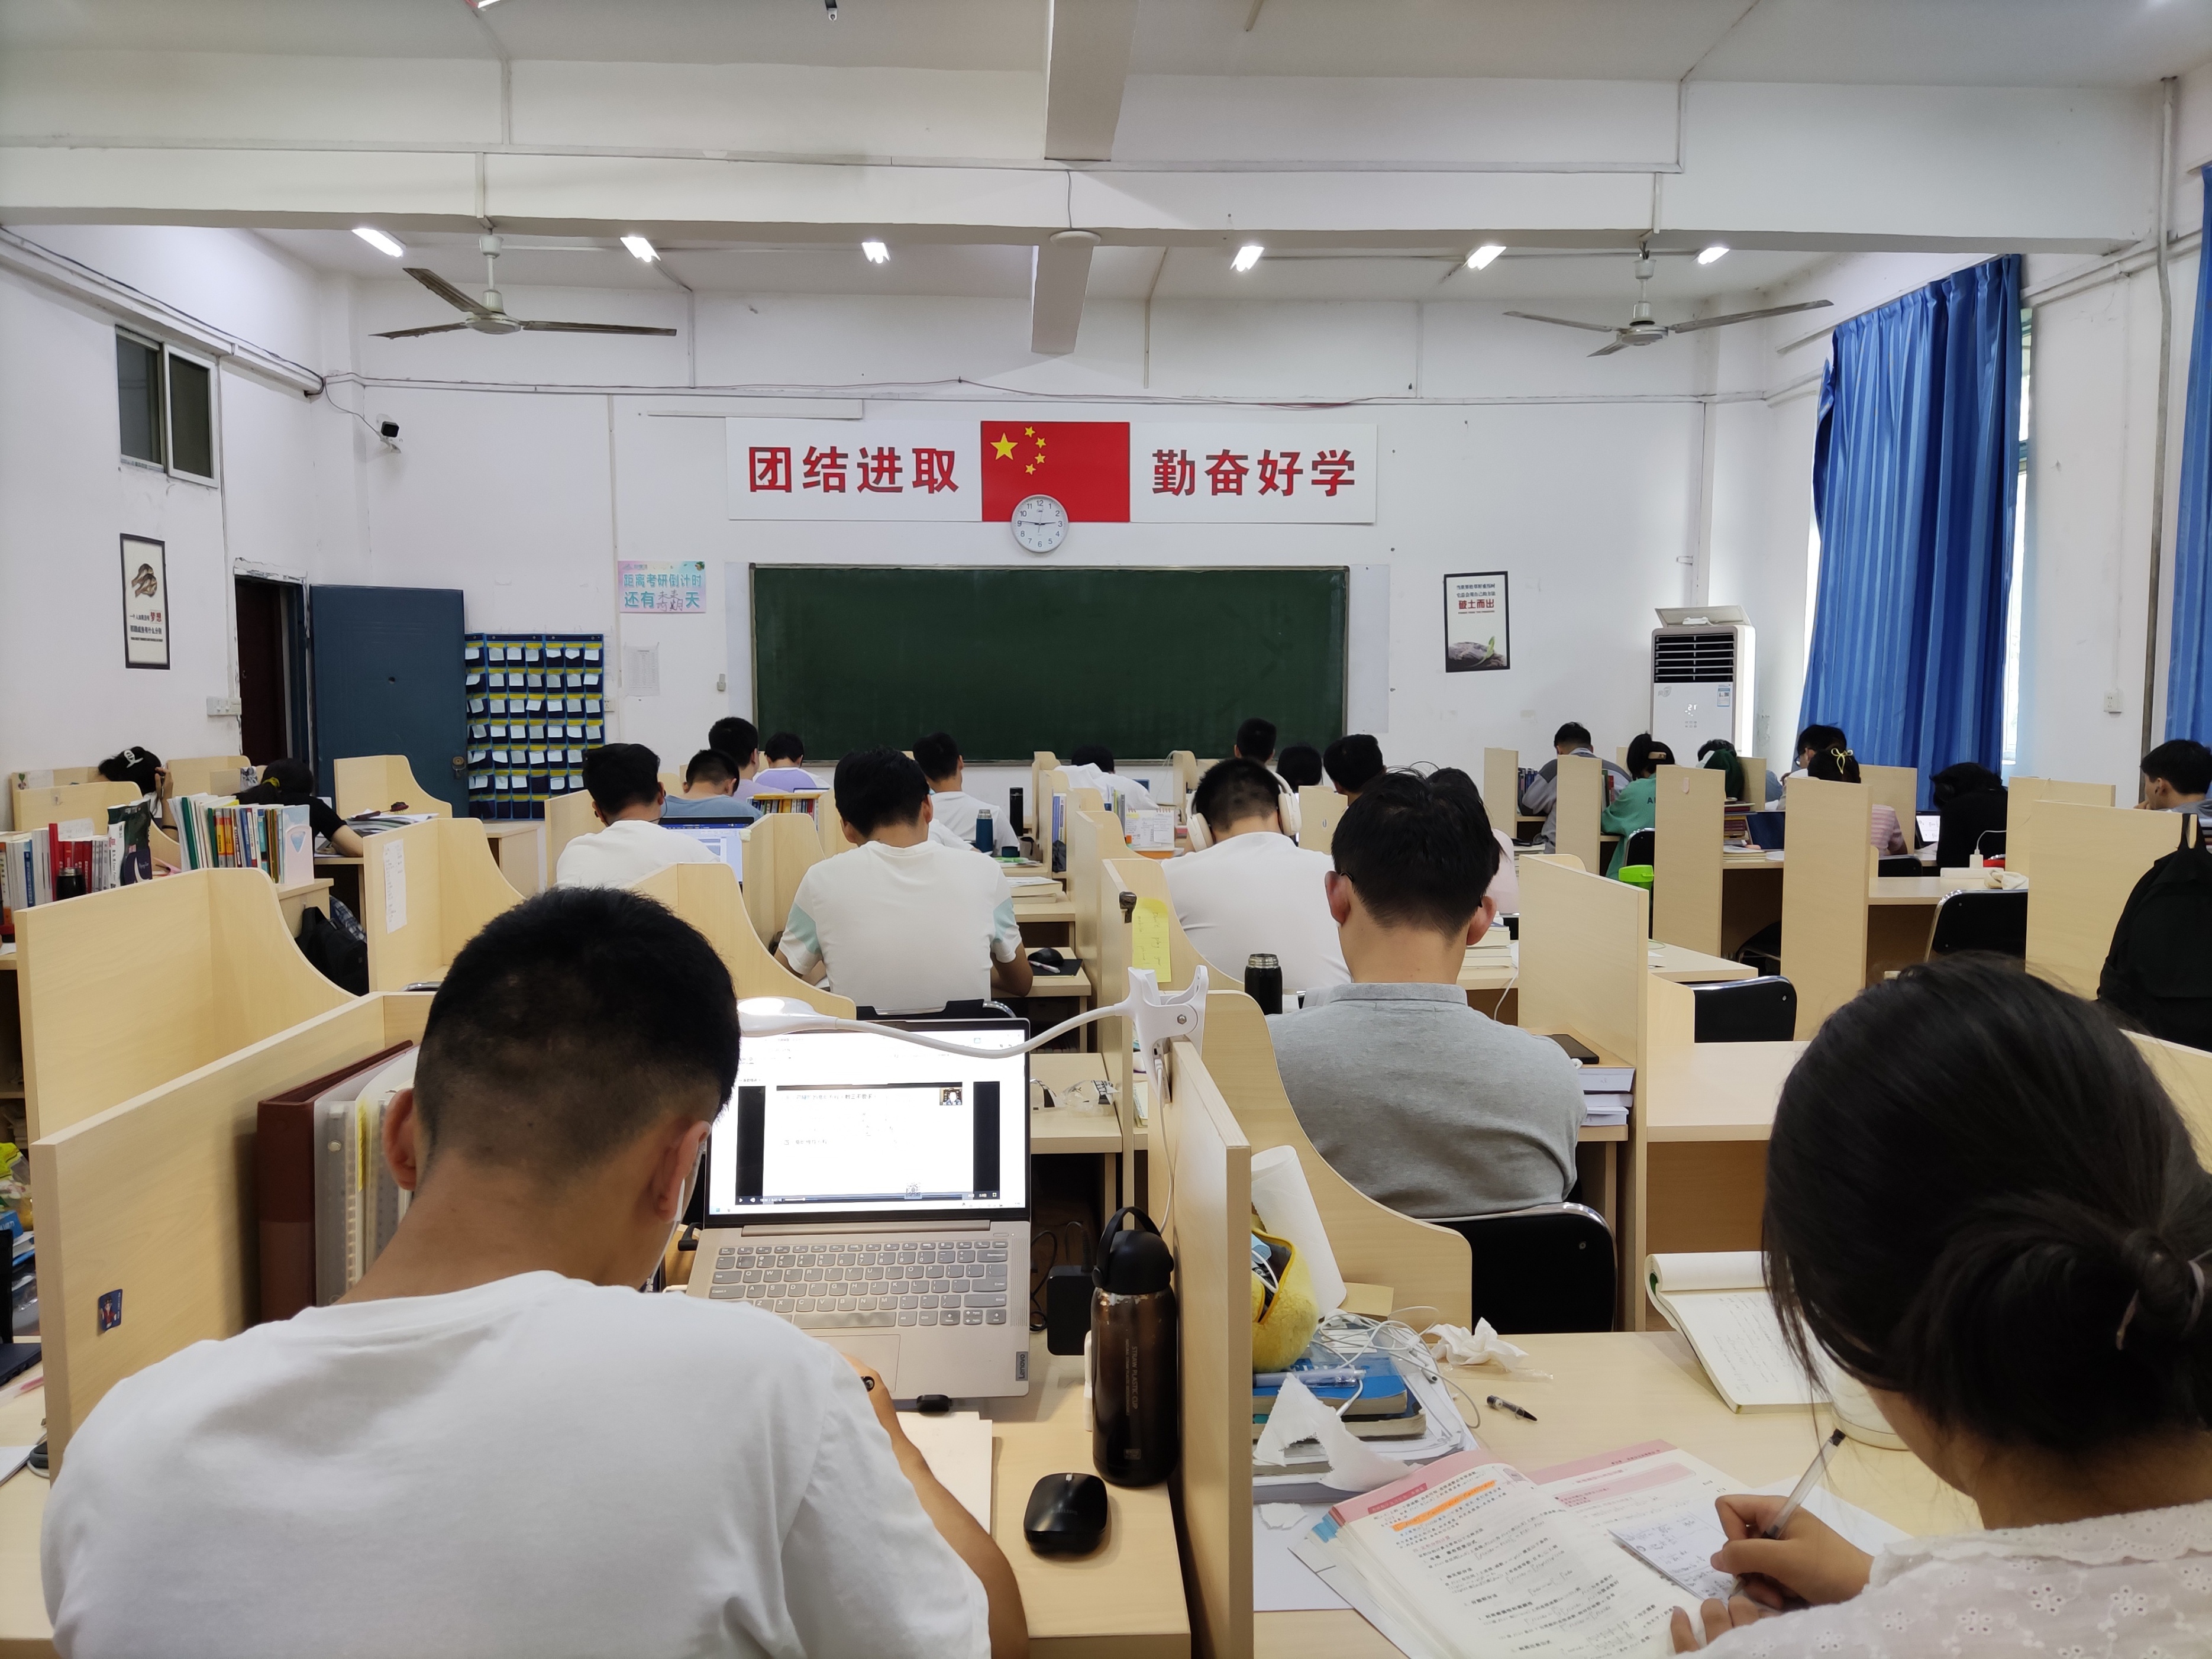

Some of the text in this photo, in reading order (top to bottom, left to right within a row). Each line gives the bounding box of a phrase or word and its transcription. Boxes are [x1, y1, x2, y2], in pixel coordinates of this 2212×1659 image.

[748, 446, 959, 493] 团结进取
[1152, 449, 1355, 496] 勤奋好学
[624, 573, 702, 588] 距离考研倒计时
[625, 591, 700, 608] 还有 天
[1458, 599, 1494, 610] 破土而出
[150, 612, 162, 622] 梦想
